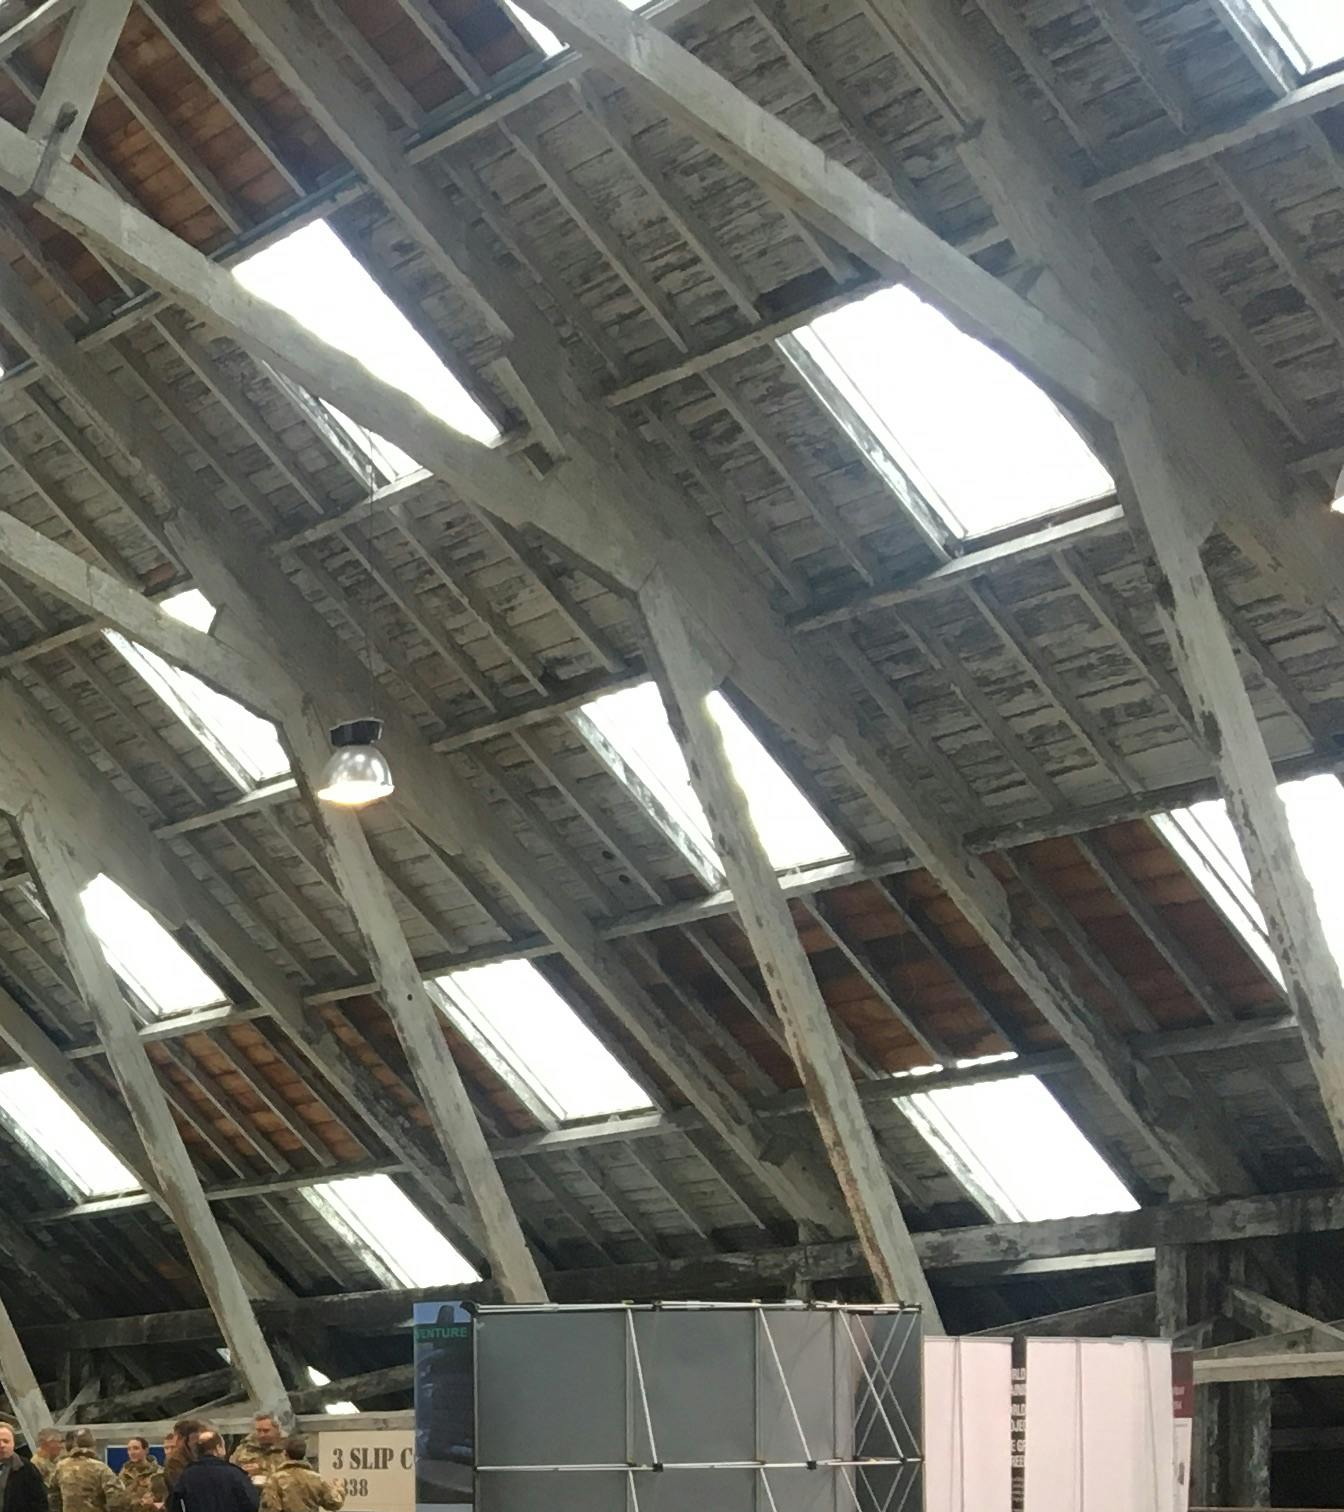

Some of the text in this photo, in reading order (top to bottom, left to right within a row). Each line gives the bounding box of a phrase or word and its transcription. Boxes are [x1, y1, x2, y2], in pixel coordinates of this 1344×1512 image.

[332, 1447, 414, 1470] 3 SLIP C
